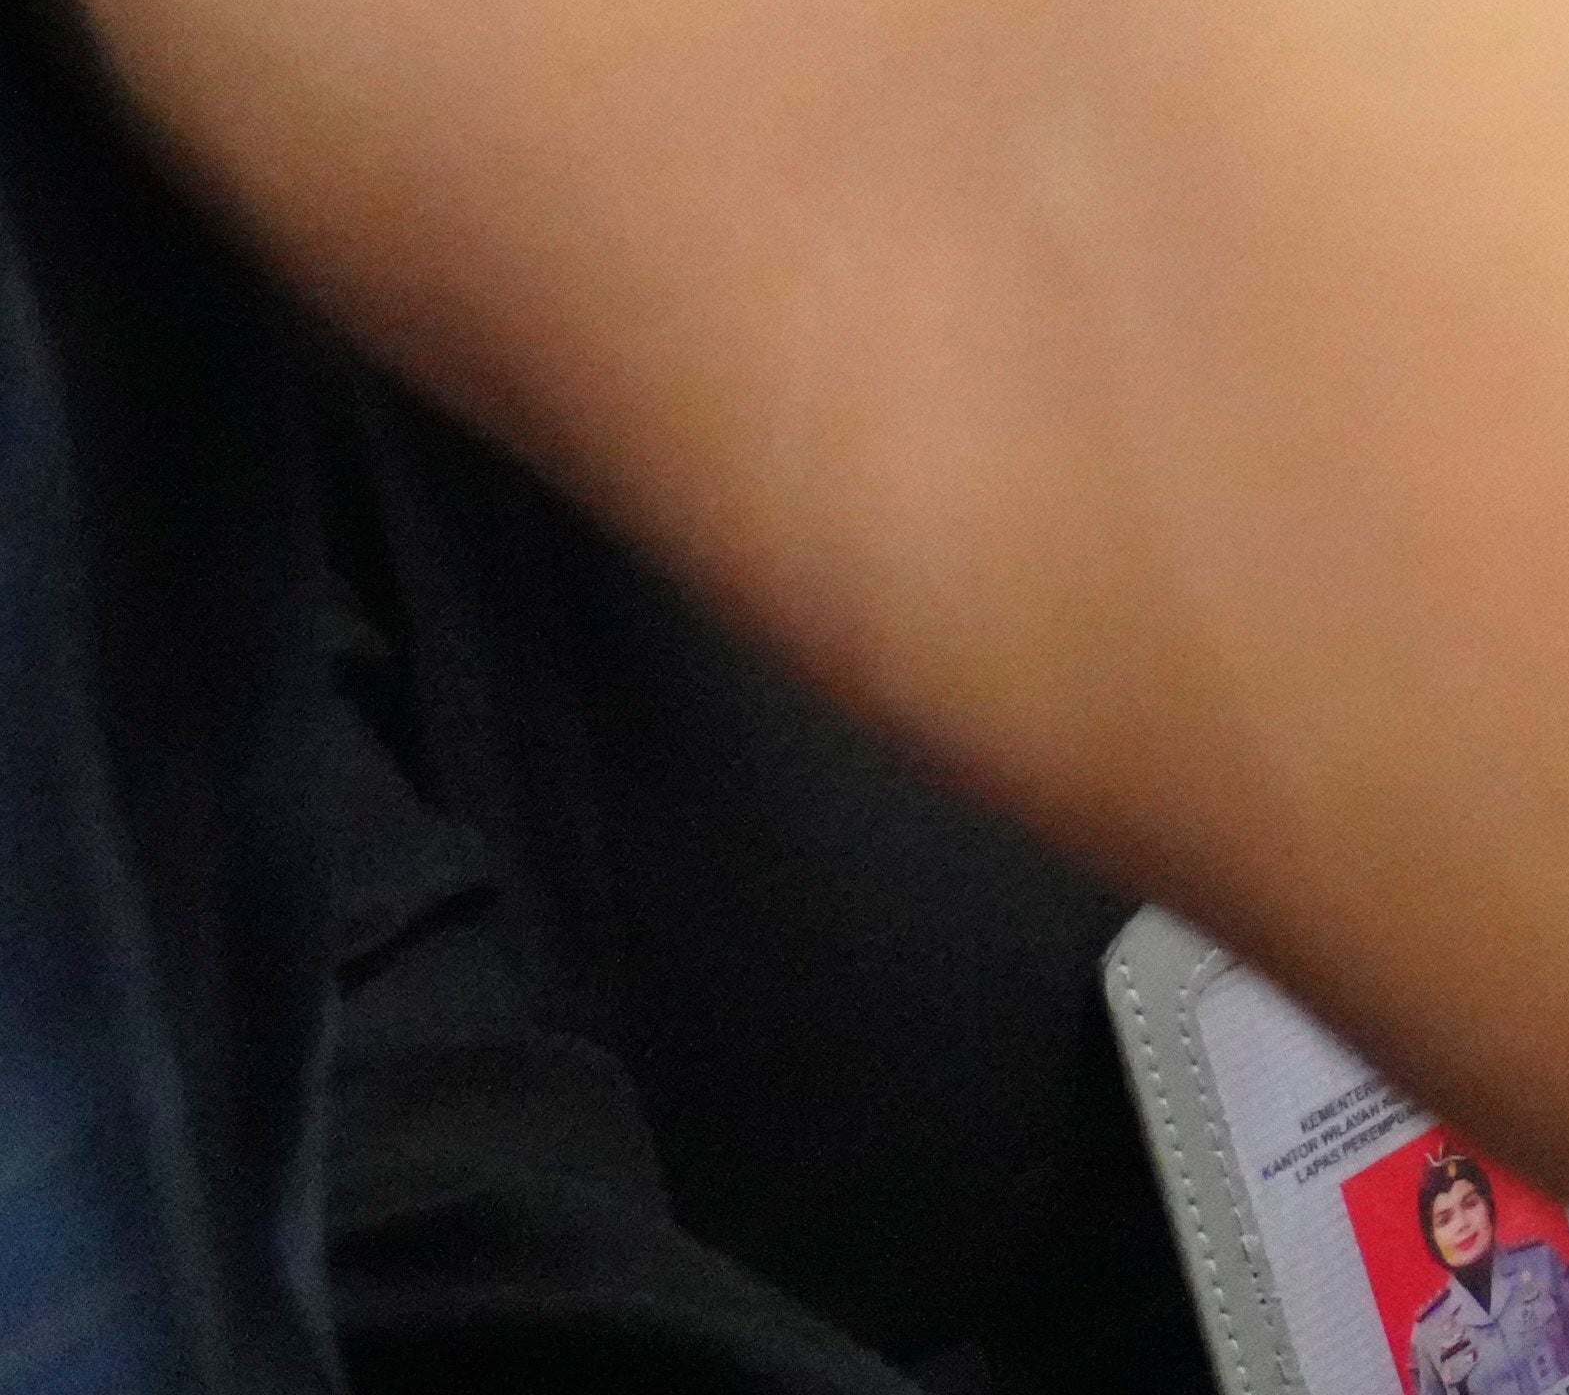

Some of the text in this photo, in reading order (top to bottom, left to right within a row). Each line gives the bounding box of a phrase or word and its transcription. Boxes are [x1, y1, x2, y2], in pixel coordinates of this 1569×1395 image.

[1300, 1077, 1384, 1134] KEMENTER
[1260, 1102, 1380, 1180] KANTOR WILAYAH
[1295, 1148, 1342, 1184] LAPAS
